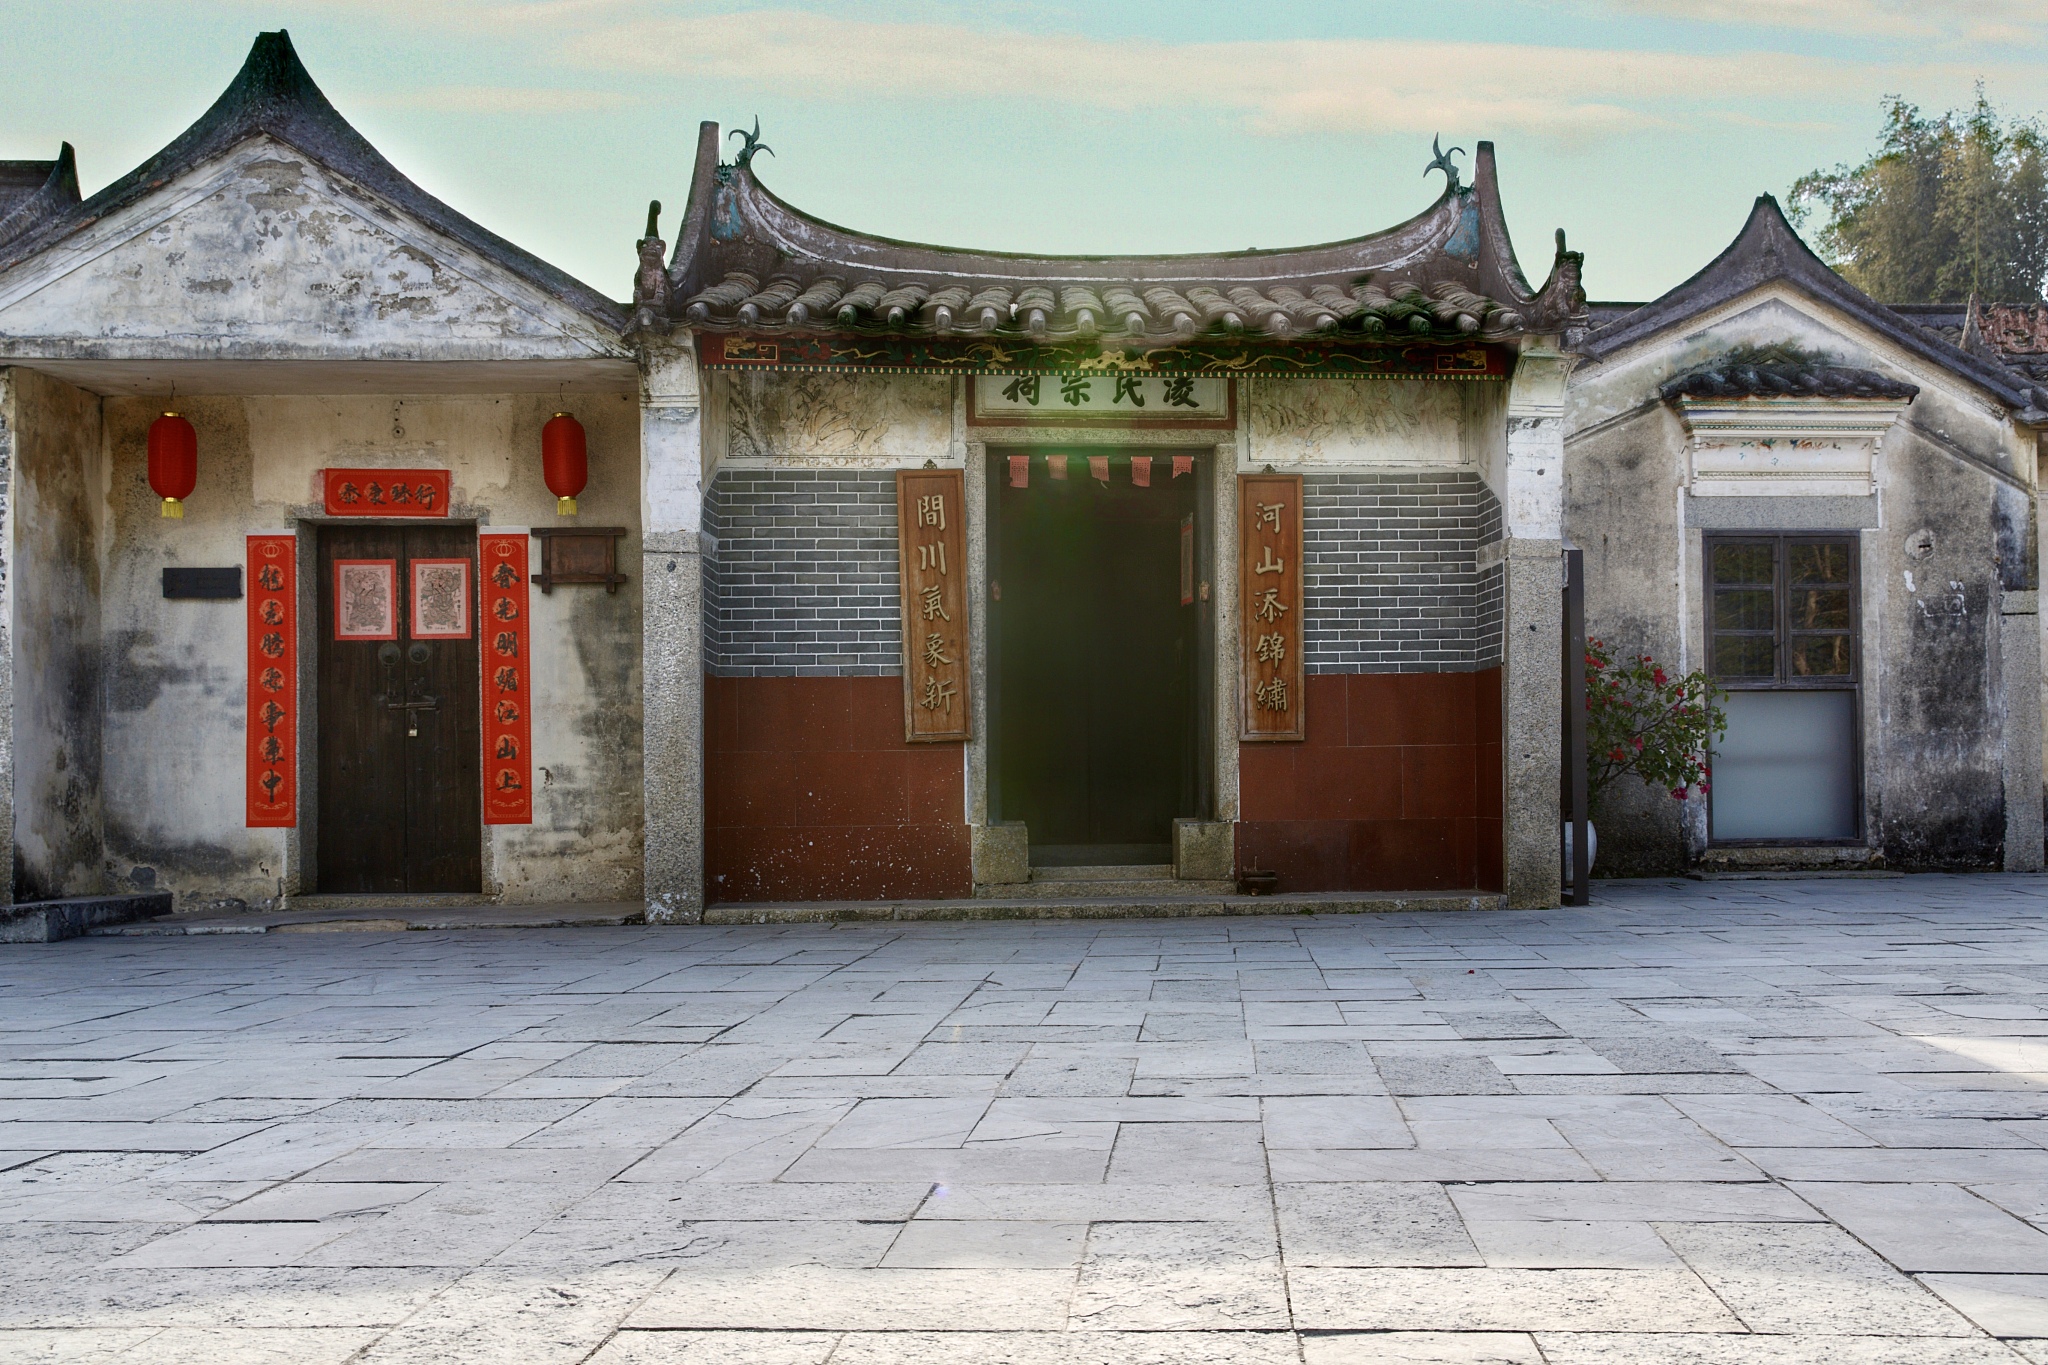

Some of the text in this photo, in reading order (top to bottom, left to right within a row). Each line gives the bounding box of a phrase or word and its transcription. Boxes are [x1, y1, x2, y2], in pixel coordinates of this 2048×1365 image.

[490, 561, 523, 792] 春光明媚江山上
[917, 494, 957, 715] 間川氣象新
[1255, 502, 1289, 712] 河山添錦繡
